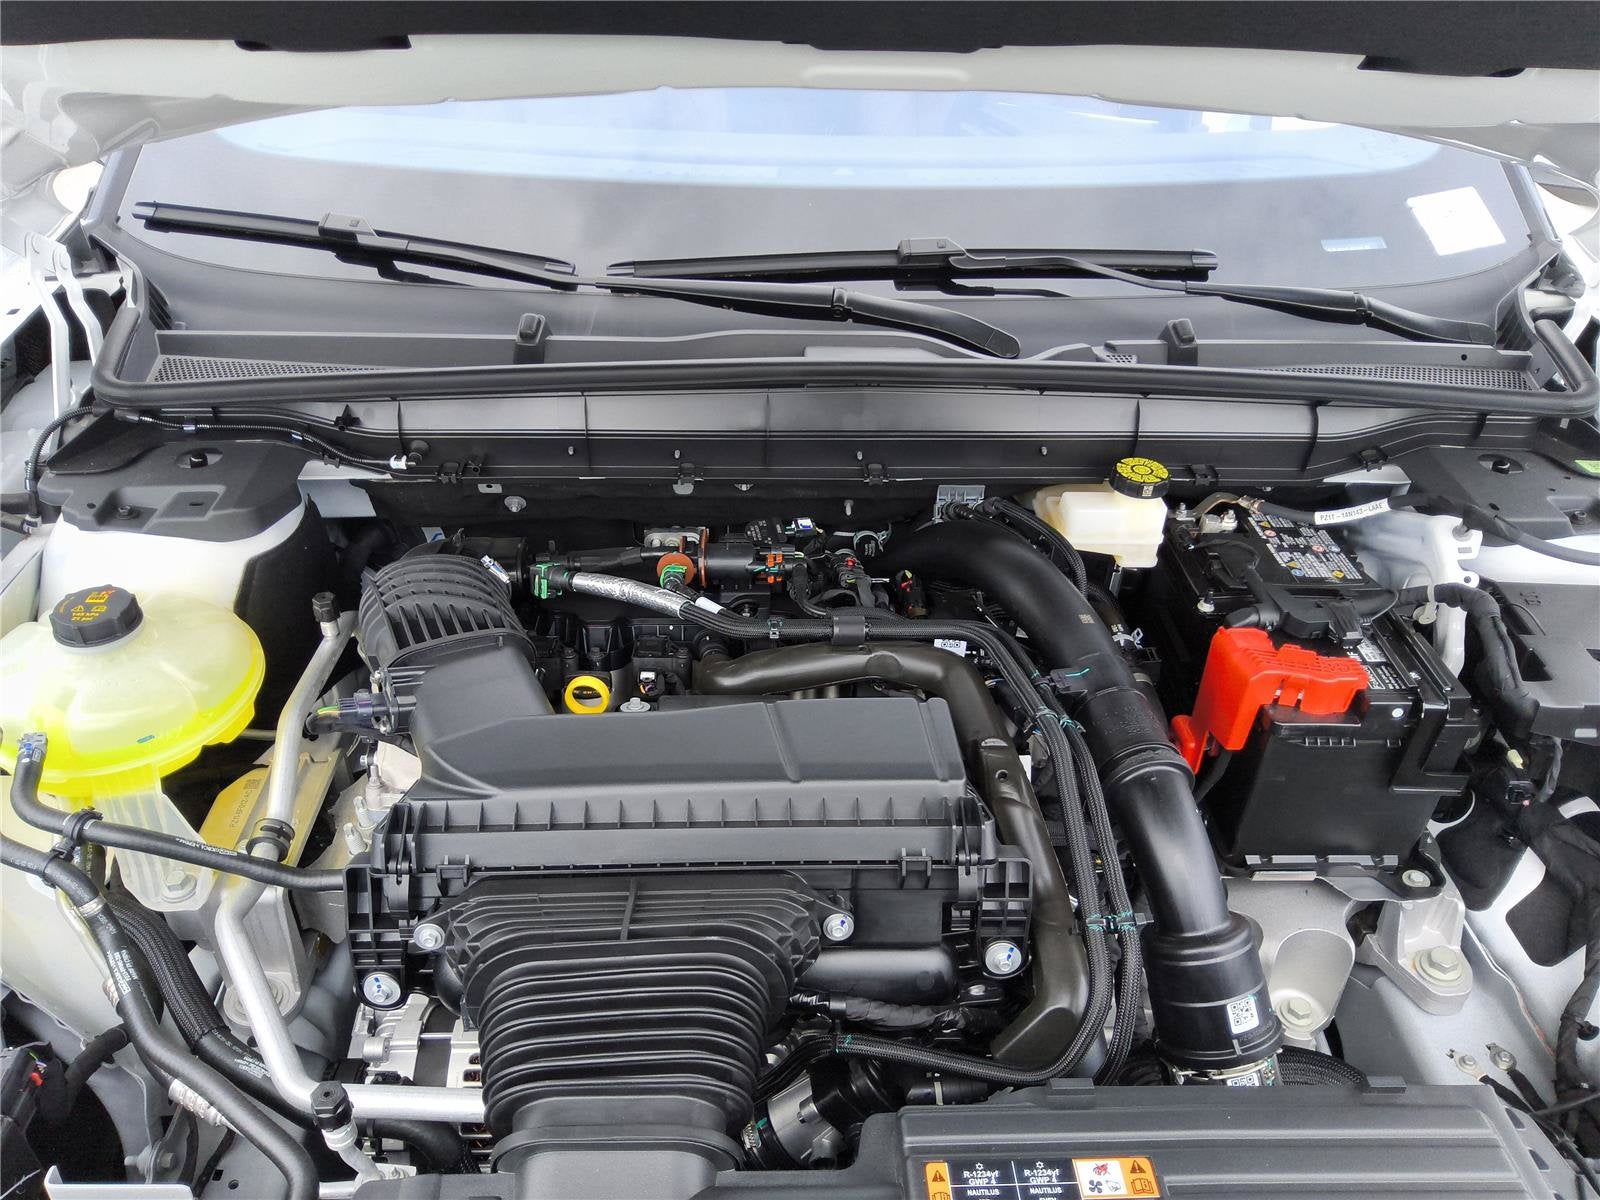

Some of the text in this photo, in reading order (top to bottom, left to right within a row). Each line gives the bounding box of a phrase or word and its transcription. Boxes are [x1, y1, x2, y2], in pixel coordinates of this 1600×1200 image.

[963, 1170, 1000, 1180] R-1234yf
[1024, 1168, 1060, 1178] R-1234yf
[968, 1177, 997, 1186] GWP 4
[1029, 1175, 1058, 1185] GWP 4
[967, 1188, 1000, 1196] NAUTILUS
[1029, 1186, 1062, 1194] NAUTILUS
